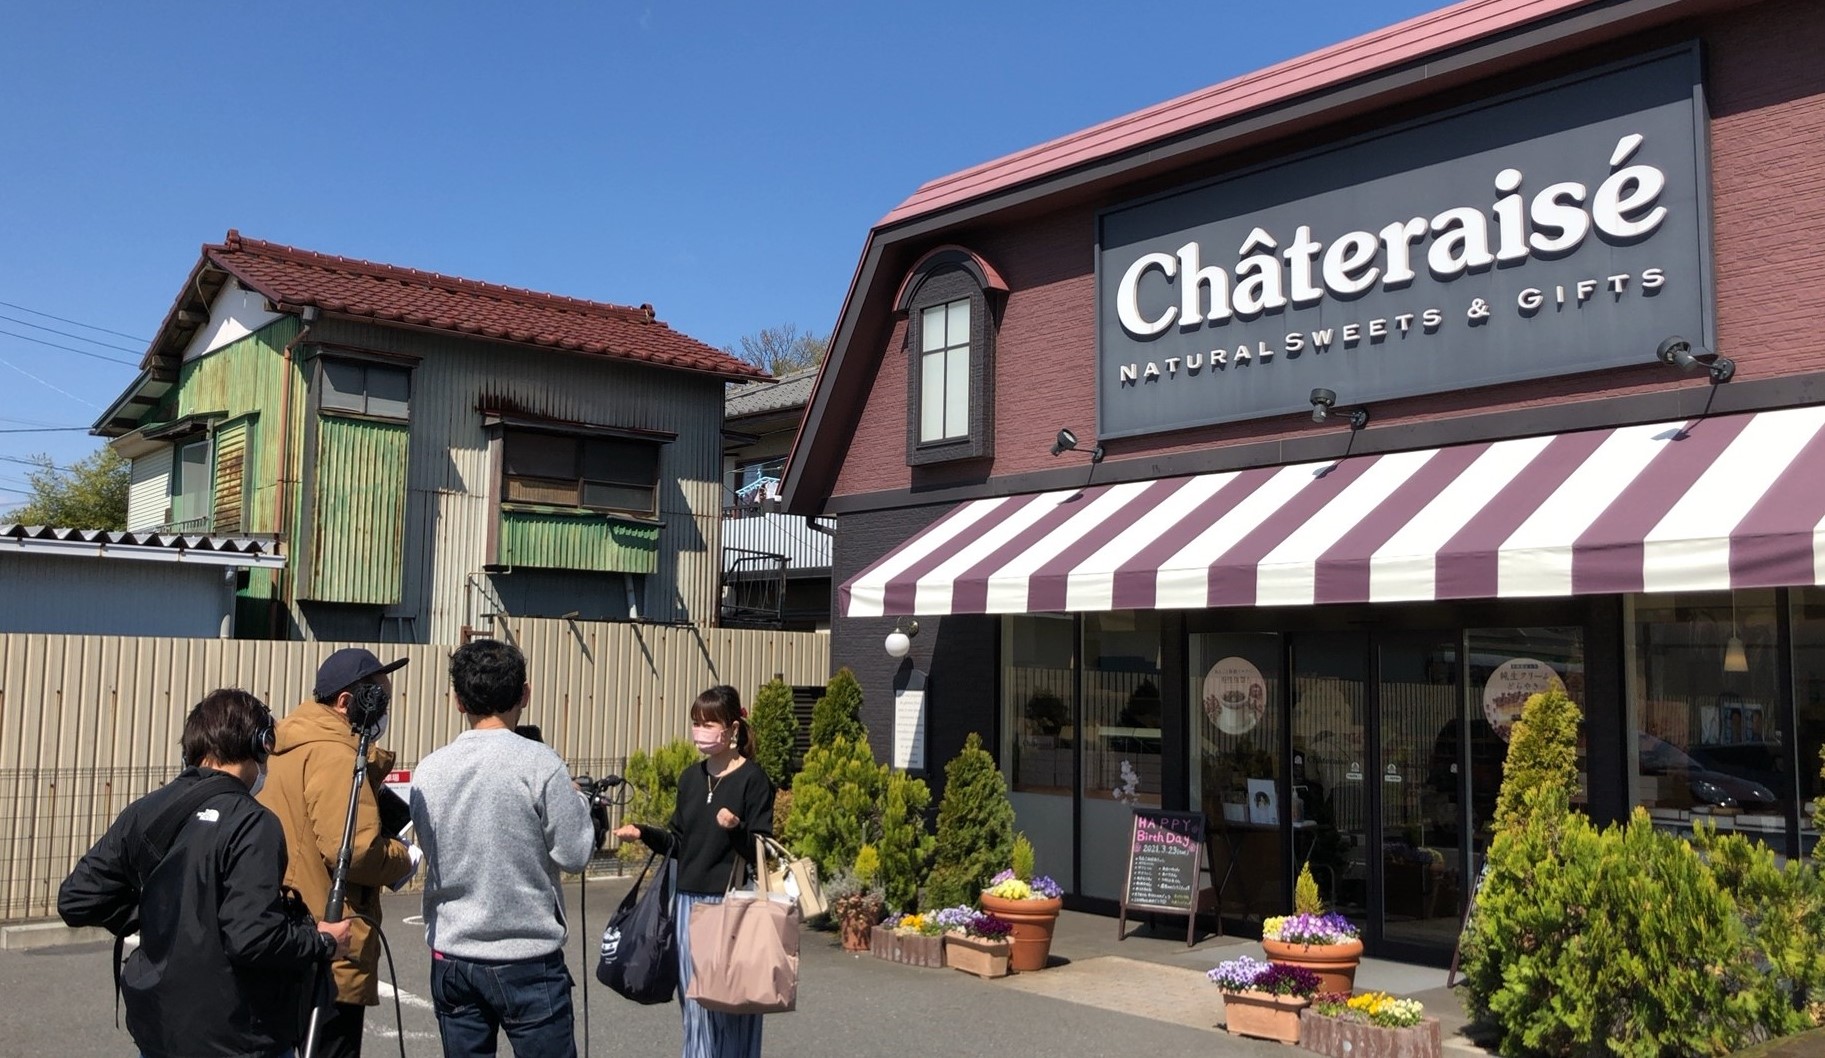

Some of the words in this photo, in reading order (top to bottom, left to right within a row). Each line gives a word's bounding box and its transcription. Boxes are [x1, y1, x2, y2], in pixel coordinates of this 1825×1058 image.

[1115, 130, 1669, 337] Châteraisé
[1118, 340, 1276, 383] NATURAL
[1284, 307, 1443, 351] SWEETS
[1466, 297, 1492, 318] &
[1517, 266, 1667, 310] GIFTS
[1138, 816, 1191, 831] HAPPY
